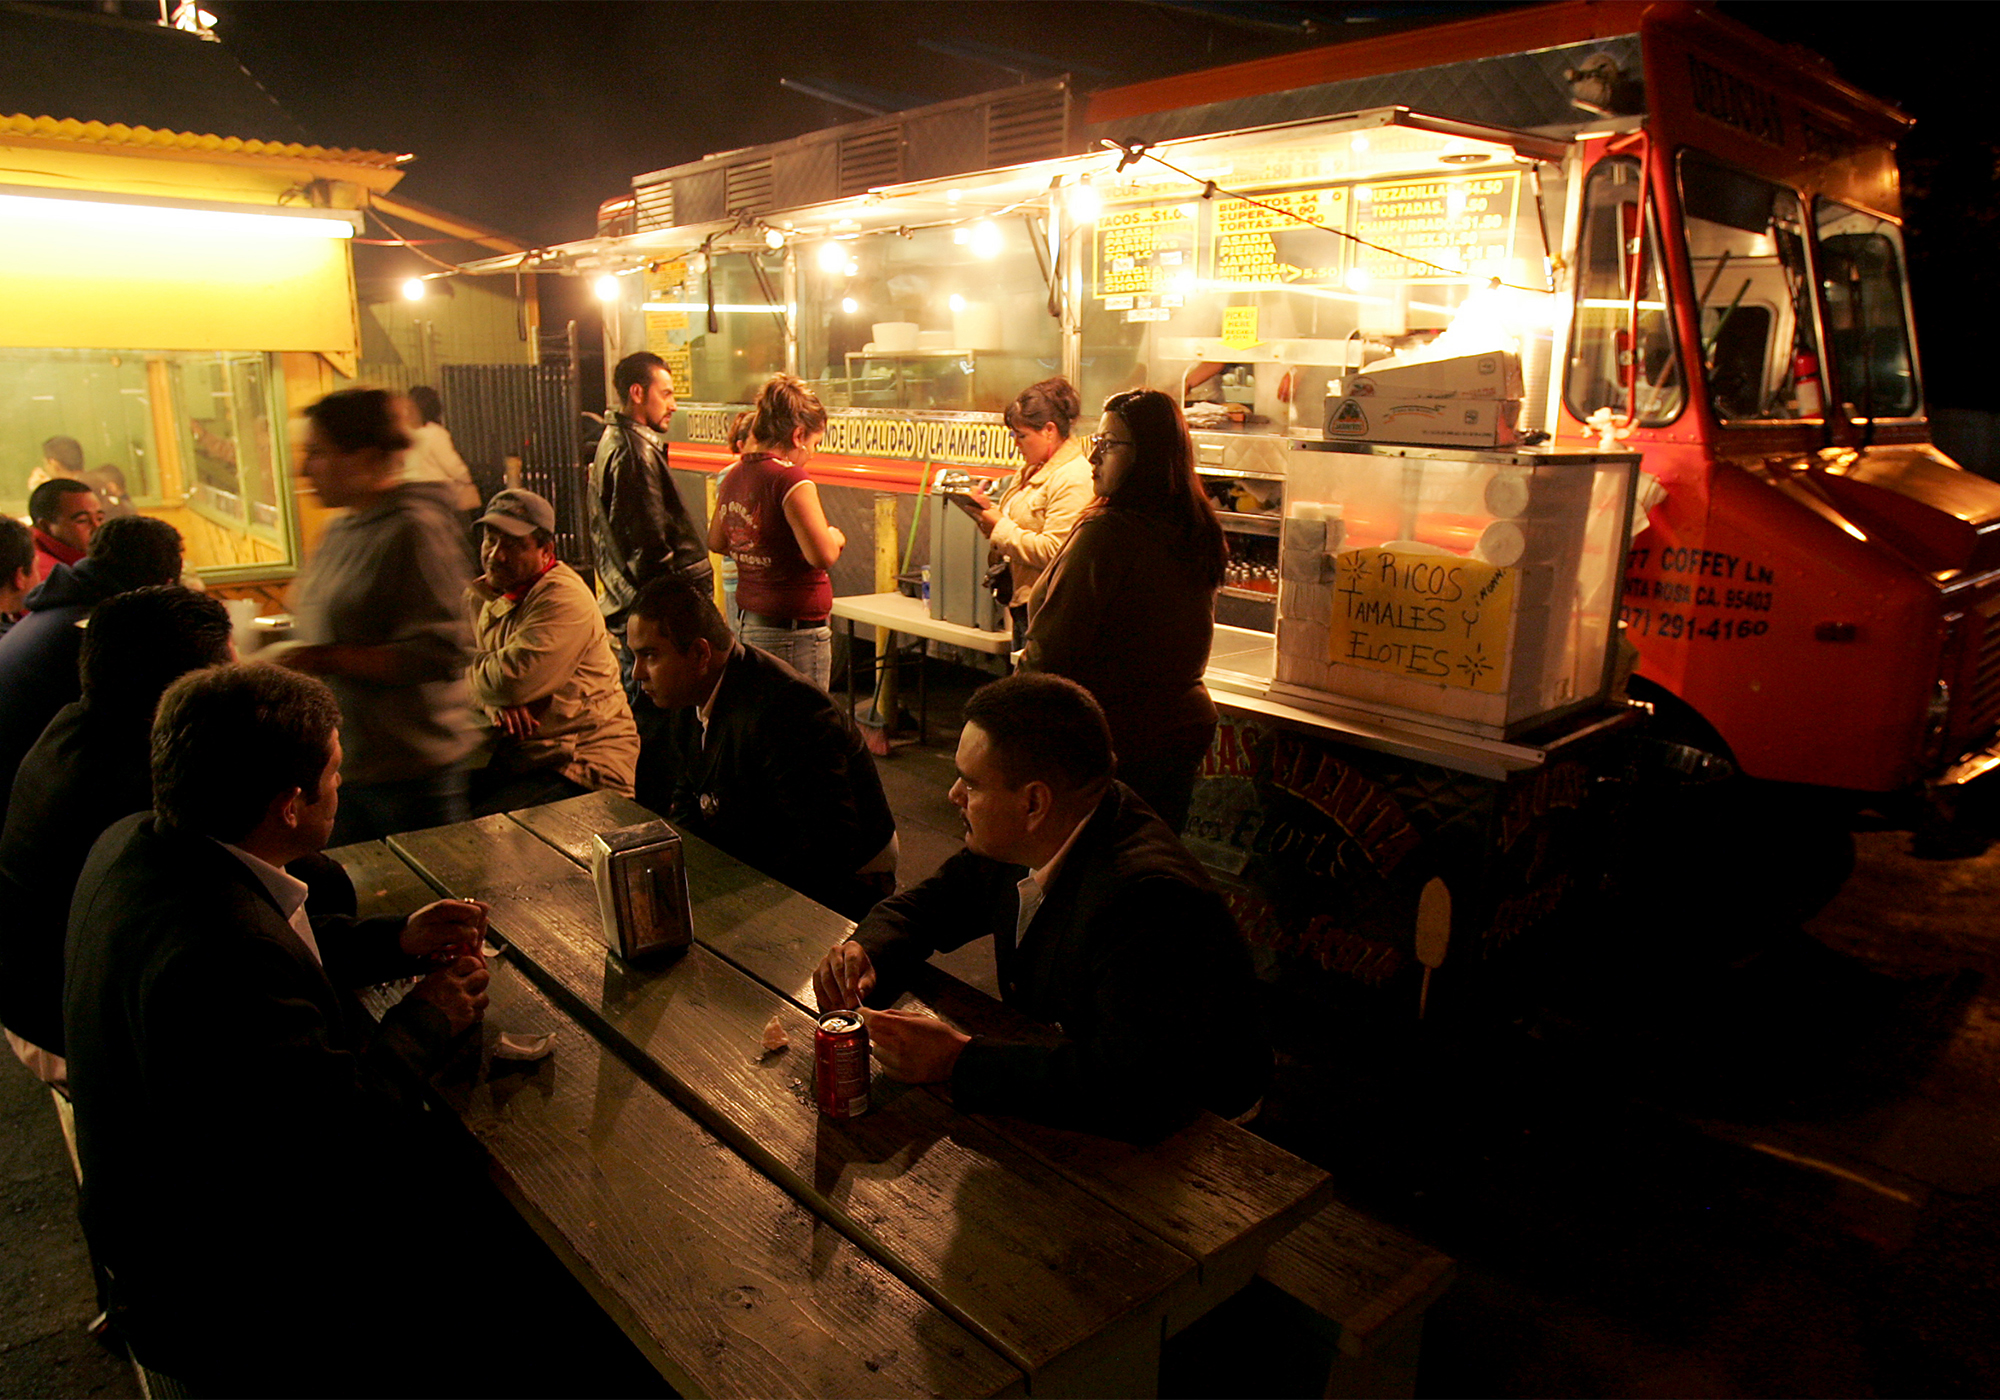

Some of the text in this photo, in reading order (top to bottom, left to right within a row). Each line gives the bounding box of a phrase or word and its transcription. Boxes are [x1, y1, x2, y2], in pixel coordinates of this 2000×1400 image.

[1218, 242, 1278, 258] PIERNA
[1219, 232, 1273, 246] ASADA
[1219, 253, 1275, 267] JAMON
[847, 419, 864, 454] LA
[864, 420, 916, 458] CALIDAD
[916, 422, 929, 460] Y
[928, 422, 947, 460] LA
[1377, 551, 1463, 603] RICOS
[1661, 546, 1741, 579] COFFEY
[1337, 577, 1480, 639] TAMALES Y
[1657, 612, 1770, 641] 291-4160
